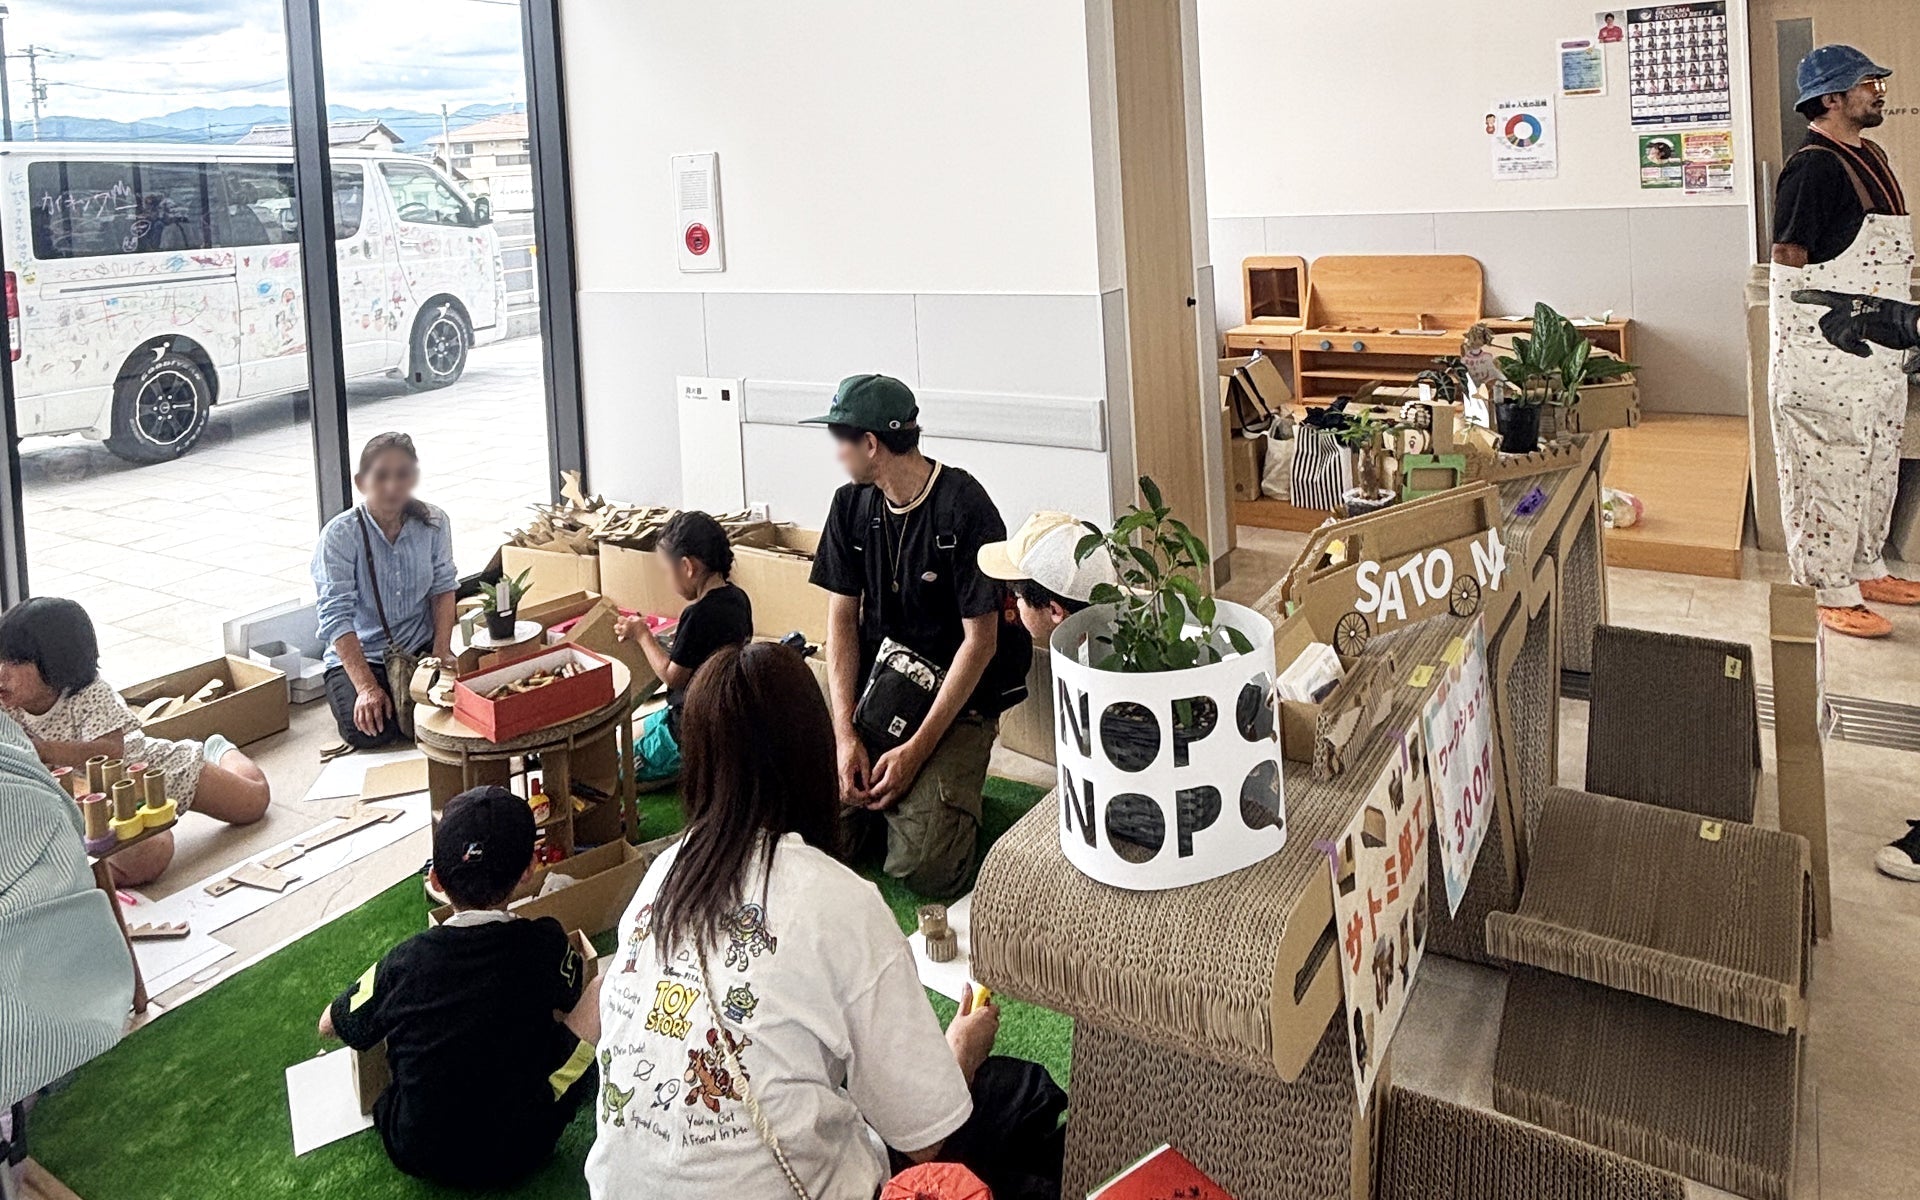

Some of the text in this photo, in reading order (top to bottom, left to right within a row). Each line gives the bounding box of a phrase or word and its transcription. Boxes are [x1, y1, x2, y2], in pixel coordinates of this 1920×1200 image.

[1883, 107, 1907, 116] TAFF
[653, 980, 701, 1020] TOY
[644, 1009, 693, 1041] STORY
[717, 1110, 735, 1125] Got
[681, 1133, 689, 1148] A
[689, 1129, 717, 1146] Friend
[719, 1128, 730, 1141] In
